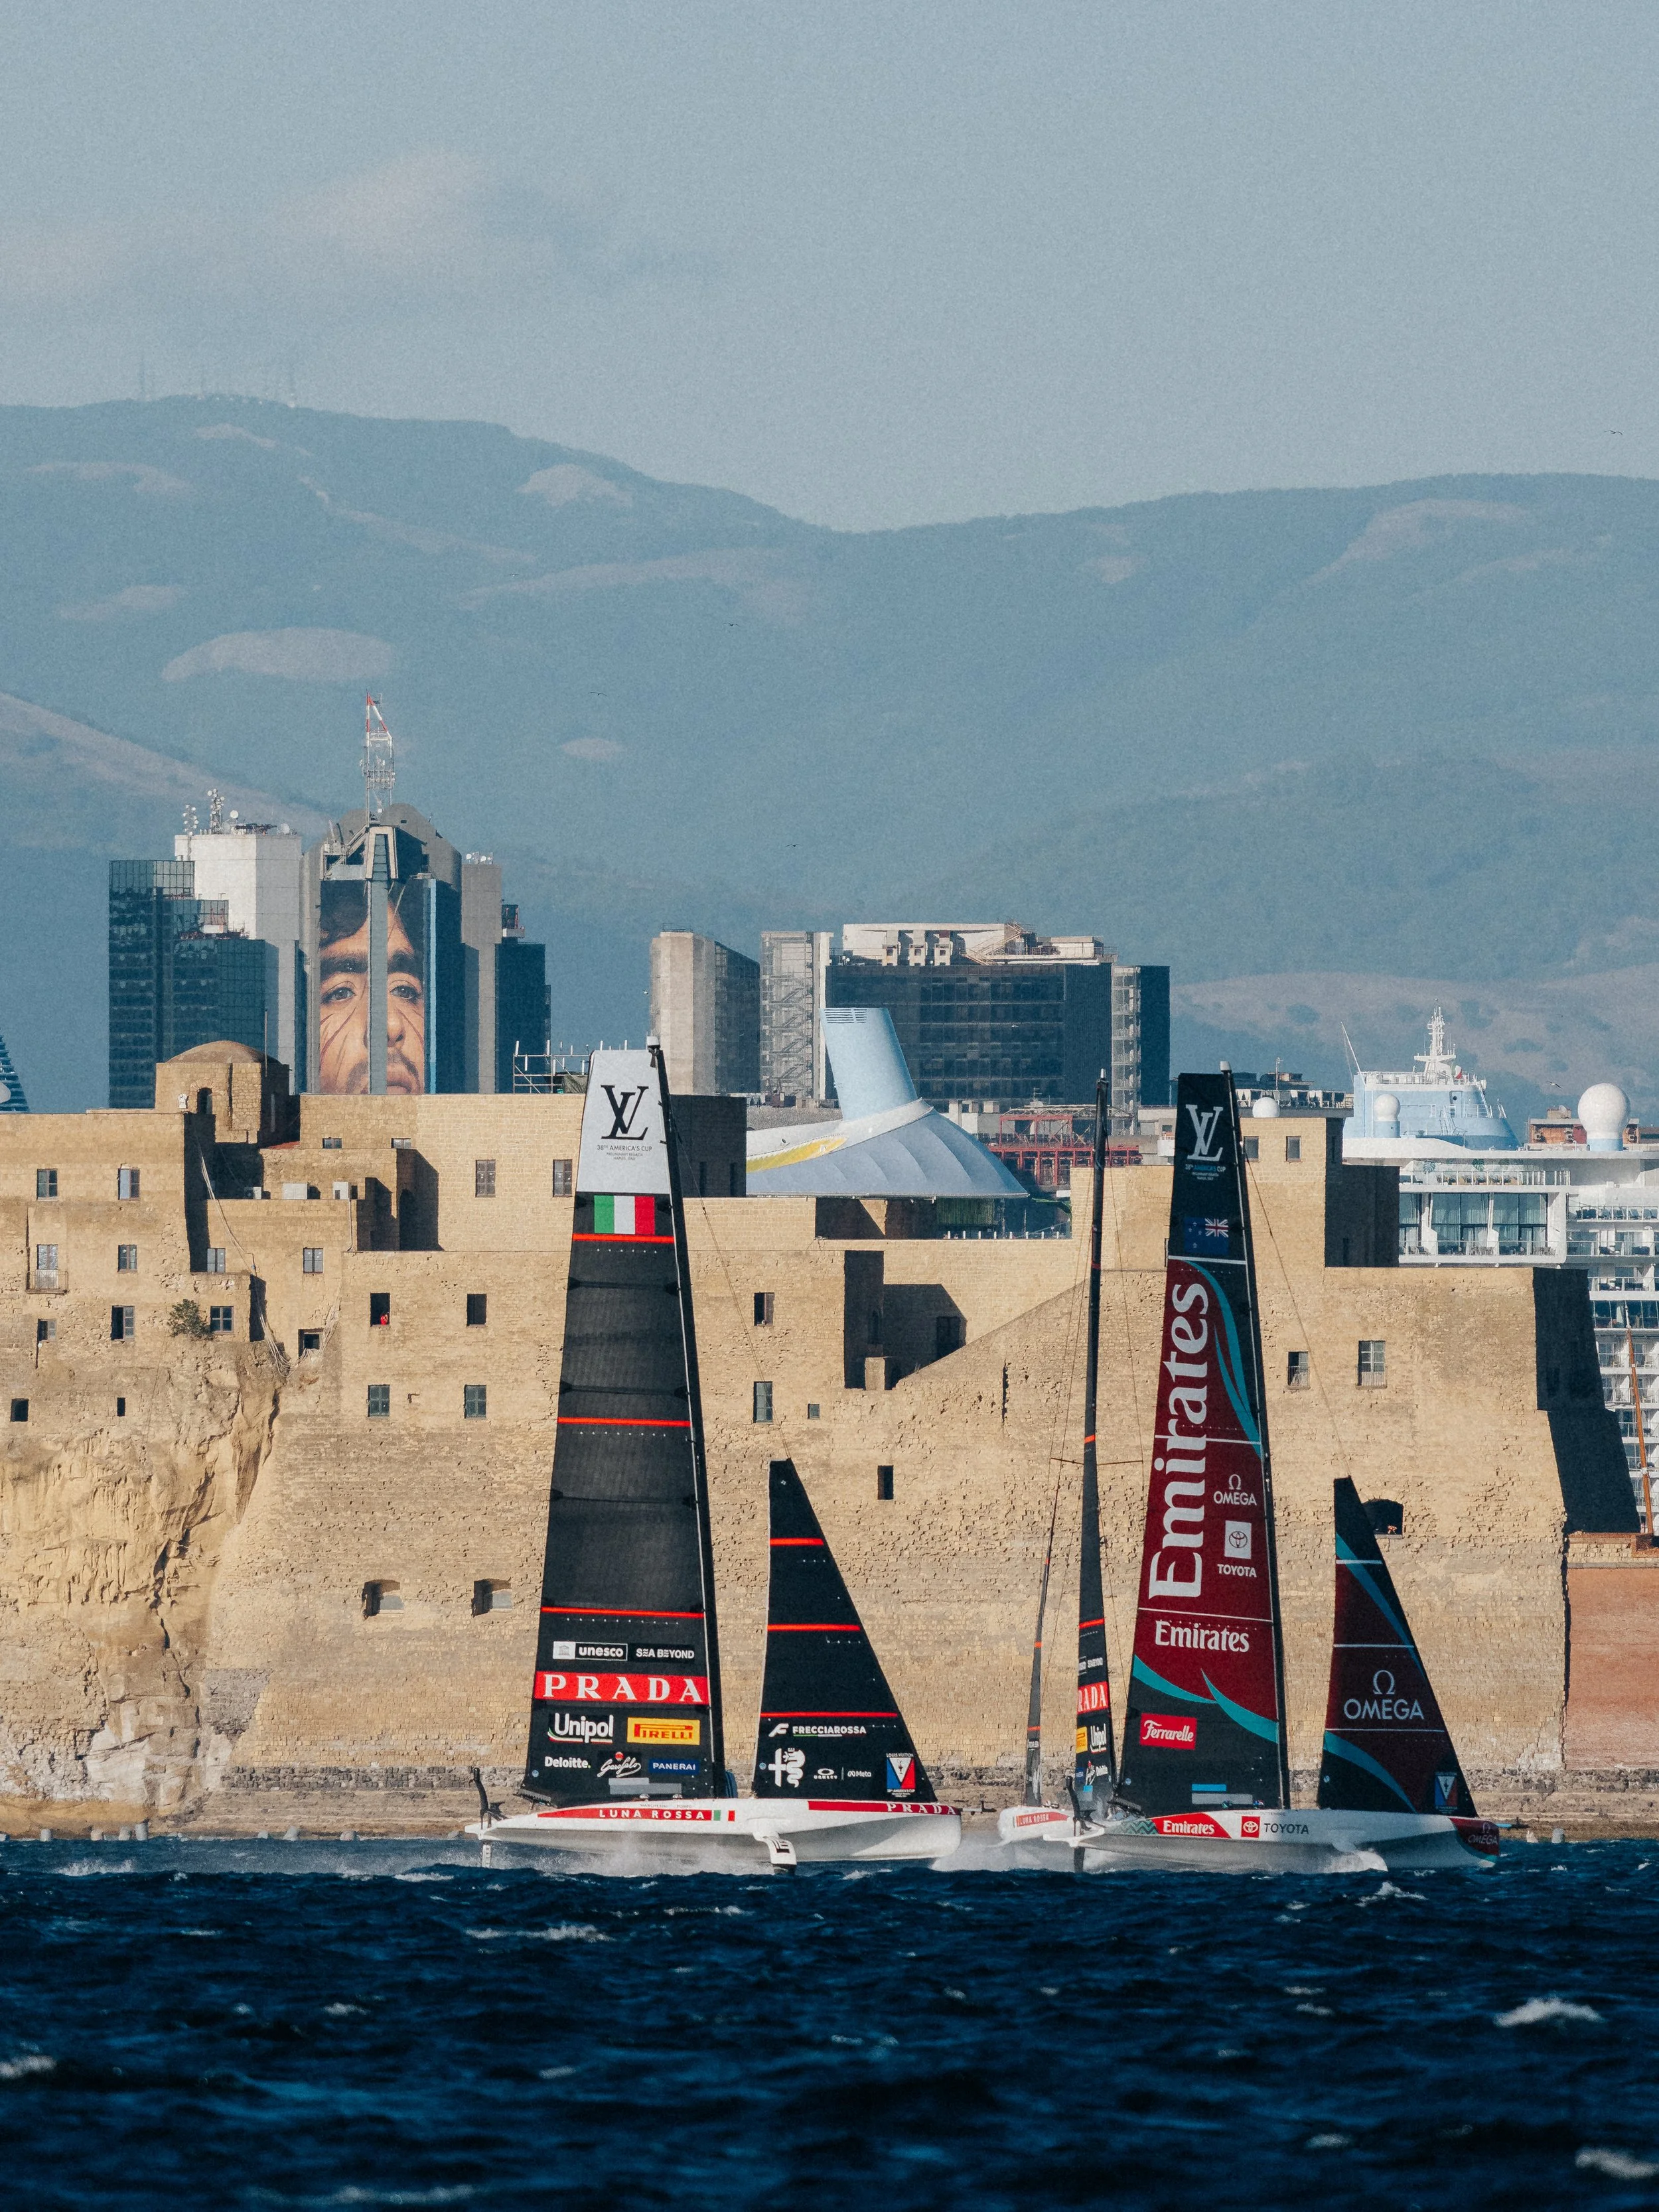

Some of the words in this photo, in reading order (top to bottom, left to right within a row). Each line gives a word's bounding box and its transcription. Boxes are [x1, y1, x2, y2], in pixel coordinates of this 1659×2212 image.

[1149, 1282, 1209, 1599] Emirates
[1213, 1490, 1257, 1505] OMEGA
[1217, 1564, 1257, 1578] TOYOTA
[1155, 1620, 1250, 1653] Emirates
[579, 1646, 624, 1657] unesco
[542, 1674, 703, 1703] PRADA
[1344, 1698, 1425, 1720] OMEGA
[554, 1712, 614, 1744] Unipol
[634, 1724, 693, 1739] PIRELLI
[792, 1726, 867, 1734] FRECCIAROSSA
[1142, 1720, 1194, 1742] Ferrarelle
[652, 1762, 695, 1771] PANERAI
[599, 1809, 642, 1818] LUNA
[652, 1810, 705, 1819] ROSSA
[886, 1801, 956, 1815] PRADA
[1163, 1820, 1215, 1834] Emirates
[1264, 1823, 1309, 1834] TOYOTA
[1467, 1834, 1498, 1844] OMEGA
